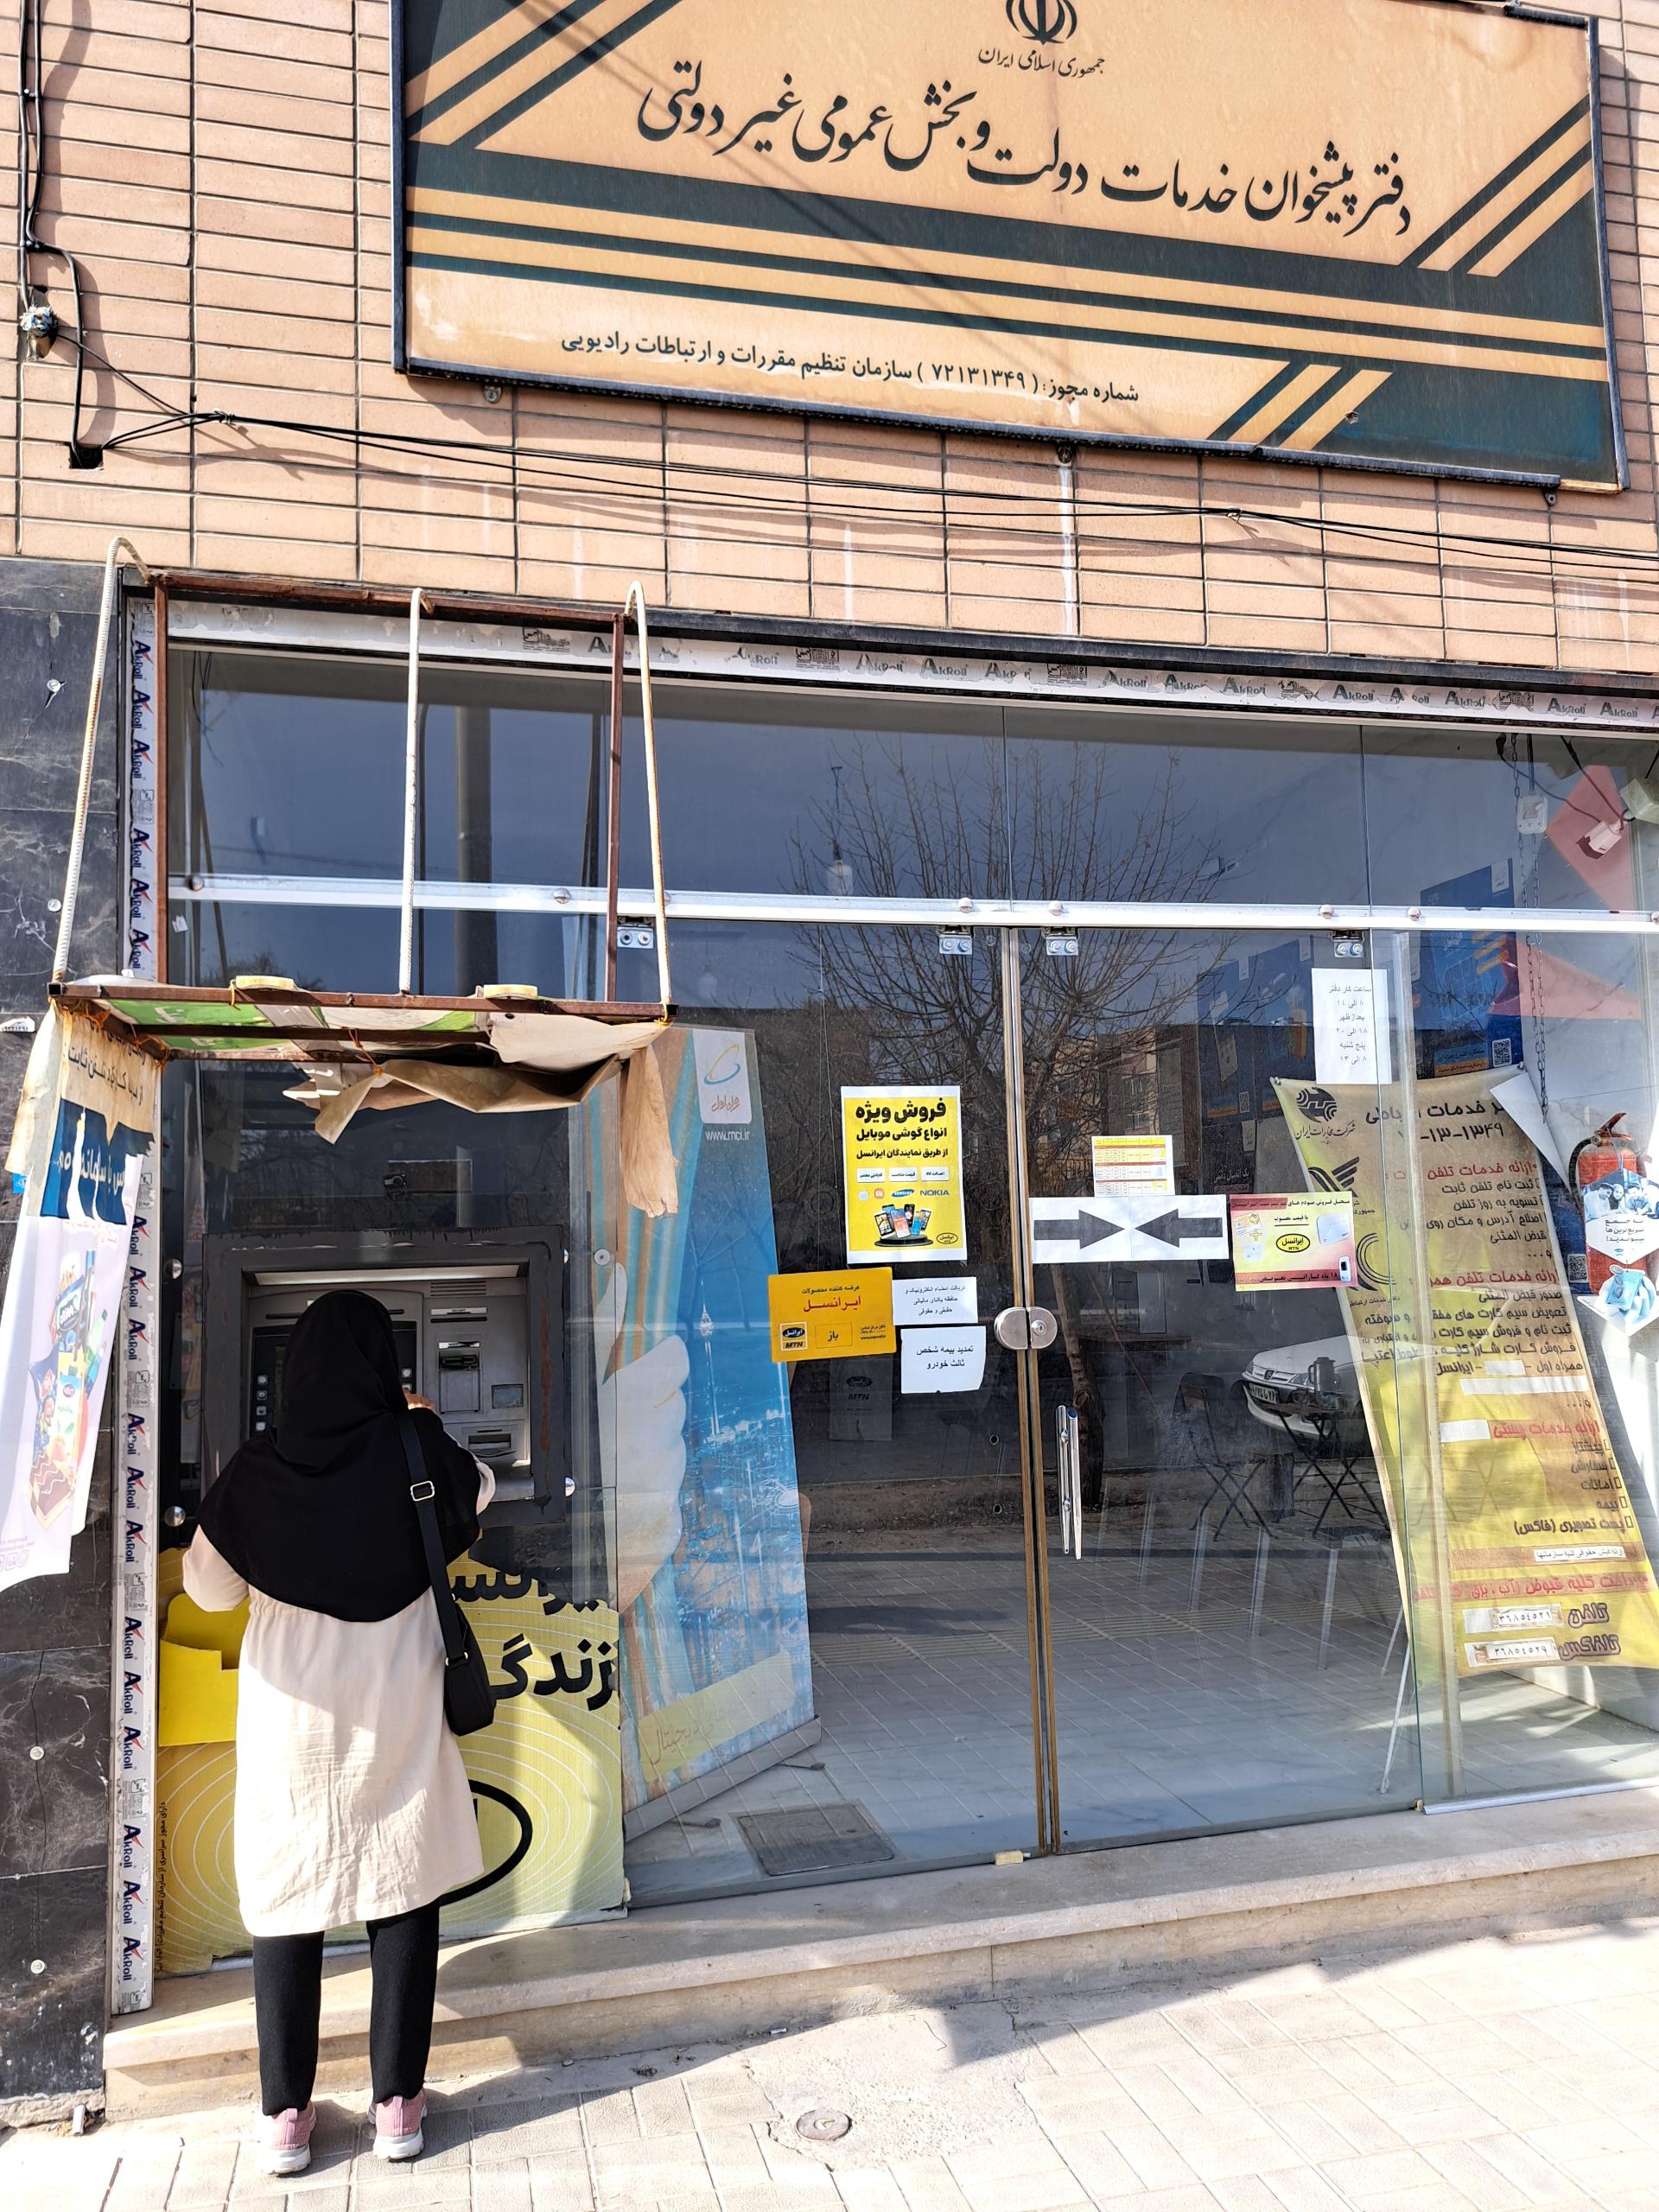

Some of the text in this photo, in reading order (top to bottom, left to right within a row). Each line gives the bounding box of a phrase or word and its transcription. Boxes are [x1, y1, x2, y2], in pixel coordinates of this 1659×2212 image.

[977, 47, 1106, 78] جمهوری اسلامی ایران
[638, 60, 1410, 237] دفتر پیشخوان خدمات دولت و بخش عمومی غیر دولتی
[561, 331, 630, 356] رادیویی
[636, 335, 712, 363] ارتباطات
[731, 345, 796, 371] مقررات
[801, 353, 848, 384] تنظیم
[852, 356, 912, 383] سازمان
[1094, 382, 1139, 403] شماره
[133, 639, 155, 681] AkRoll
[920, 658, 967, 677] AkRoll
[1332, 683, 1374, 701] AkRoll
[1547, 697, 1586, 715] AkRoll
[131, 738, 151, 780] AkRoll
[131, 828, 152, 869] AkRoll
[130, 927, 150, 970] AkRoll
[855, 1097, 946, 1123] فروش ویژه
[1427, 1101, 1485, 1117] خدمات
[705, 1129, 751, 1141] www.mci.ir
[856, 1127, 947, 1141] انواع گوشی موبایل
[856, 1149, 885, 1160] ایرانسل
[887, 1148, 921, 1158] نمایندگان
[923, 1149, 941, 1159] طریق
[1427, 1166, 1454, 1179] تلفن
[1459, 1163, 1503, 1175] خدمات
[1442, 1179, 1534, 1193] ثبت نام تلفن ثابت
[1453, 1199, 1475, 1211] تلفن
[1510, 1197, 1538, 1206] تسویه
[1427, 1220, 1443, 1230] روی
[1447, 1217, 1473, 1228] مکان
[1487, 1211, 1515, 1226] آدرس
[1519, 1213, 1542, 1226] اصلاح
[1282, 1237, 1303, 1246] ایرانسل
[1491, 1230, 1547, 1243] قبض المثنی
[1457, 1272, 1484, 1287] تلفن
[1490, 1271, 1532, 1282] خدمات
[803, 1295, 861, 1313] ایرانسل
[1456, 1310, 1474, 1321] های
[1478, 1309, 1503, 1319] کارت
[1506, 1309, 1528, 1319] سیم
[1532, 1308, 1567, 1318] تعویض
[1439, 1327, 1464, 1338] کارت
[1467, 1329, 1489, 1339] سیم
[1493, 1325, 1522, 1338] فروش
[1534, 1325, 1548, 1337] نام
[1553, 1324, 1572, 1334] ثبت
[129, 1319, 148, 1361] AkRoll
[828, 1332, 839, 1342] باز
[917, 1346, 938, 1356] شخص
[1473, 1340, 1500, 1355] شارژ
[1503, 1343, 1537, 1353] کارت
[1541, 1339, 1576, 1355] فروش
[926, 1358, 964, 1369] ثالث خودرو
[1436, 1359, 1583, 1376] همراه اول ایرانسل
[1493, 1422, 1525, 1440] پستی
[126, 1466, 147, 1510] AkRoll
[1581, 1479, 1614, 1490] امانات
[1597, 1502, 1618, 1510] بیمه
[1560, 1517, 1597, 1532] تصویری
[1526, 1576, 1562, 1595] قبوض
[1567, 1575, 1594, 1591] کلیه
[1567, 1602, 1610, 1629] تلفن
[1557, 1634, 1621, 1662] تلفکس
[491, 1633, 617, 1711] زندگ
[123, 1670, 143, 1715] AkRoll
[123, 1824, 144, 1868] AkRoll
[123, 1880, 144, 1925] AkRoll
